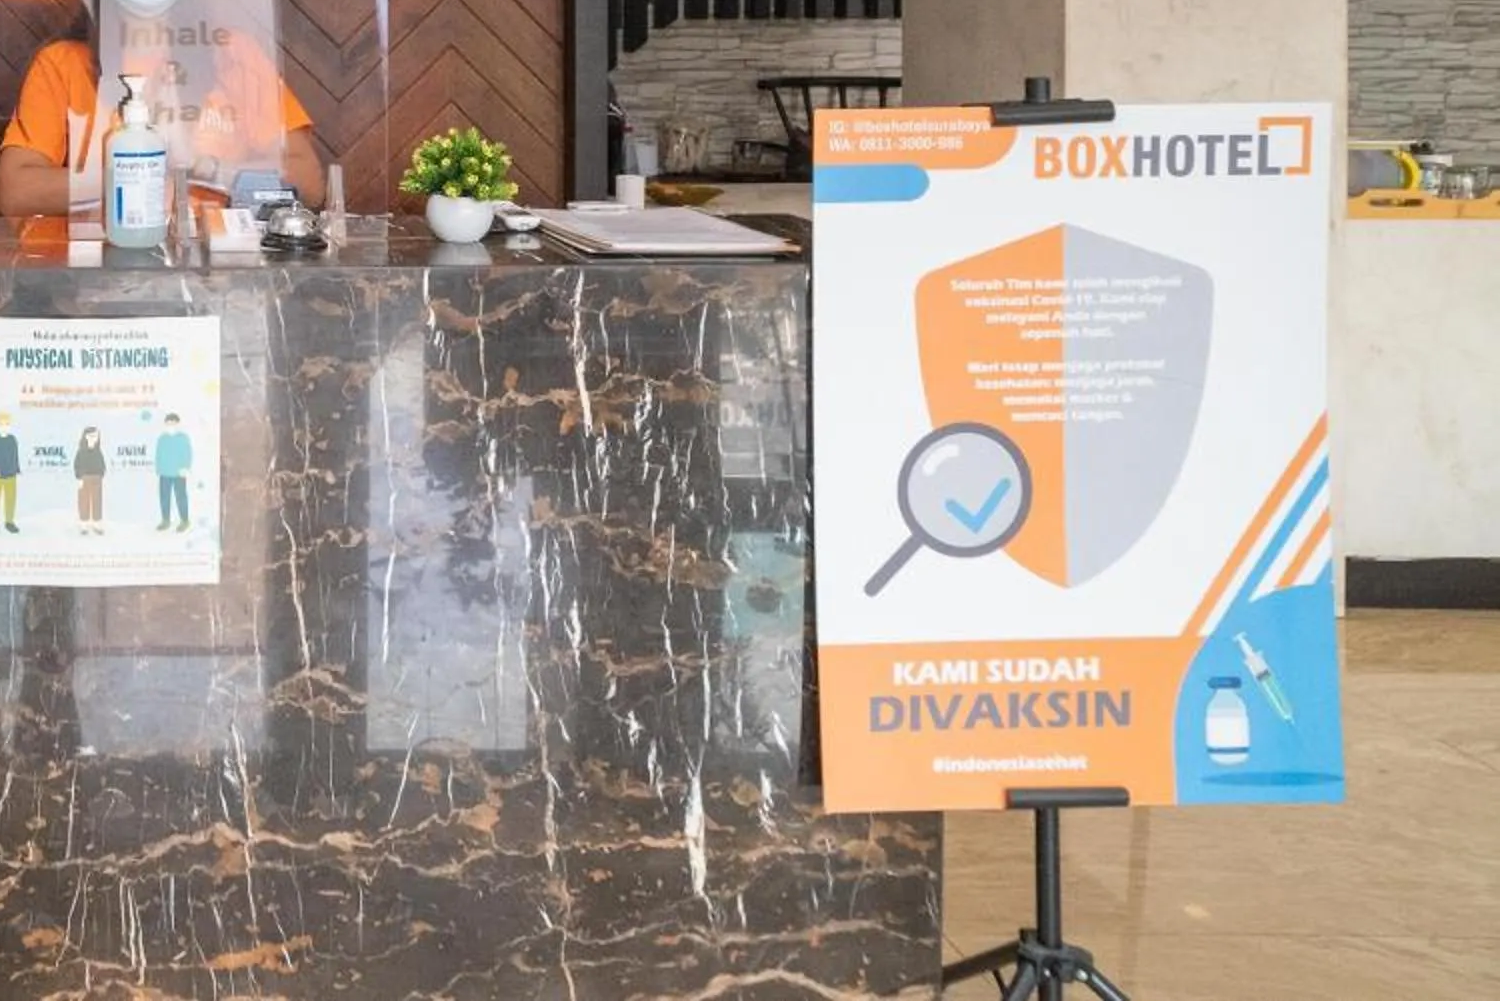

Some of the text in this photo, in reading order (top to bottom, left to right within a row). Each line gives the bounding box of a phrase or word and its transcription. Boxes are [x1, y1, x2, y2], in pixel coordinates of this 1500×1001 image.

[1034, 133, 1282, 179] BOXHOTEL
[894, 657, 1099, 686] KAMI SUDAH
[869, 691, 1131, 732] DIVAKSIN
